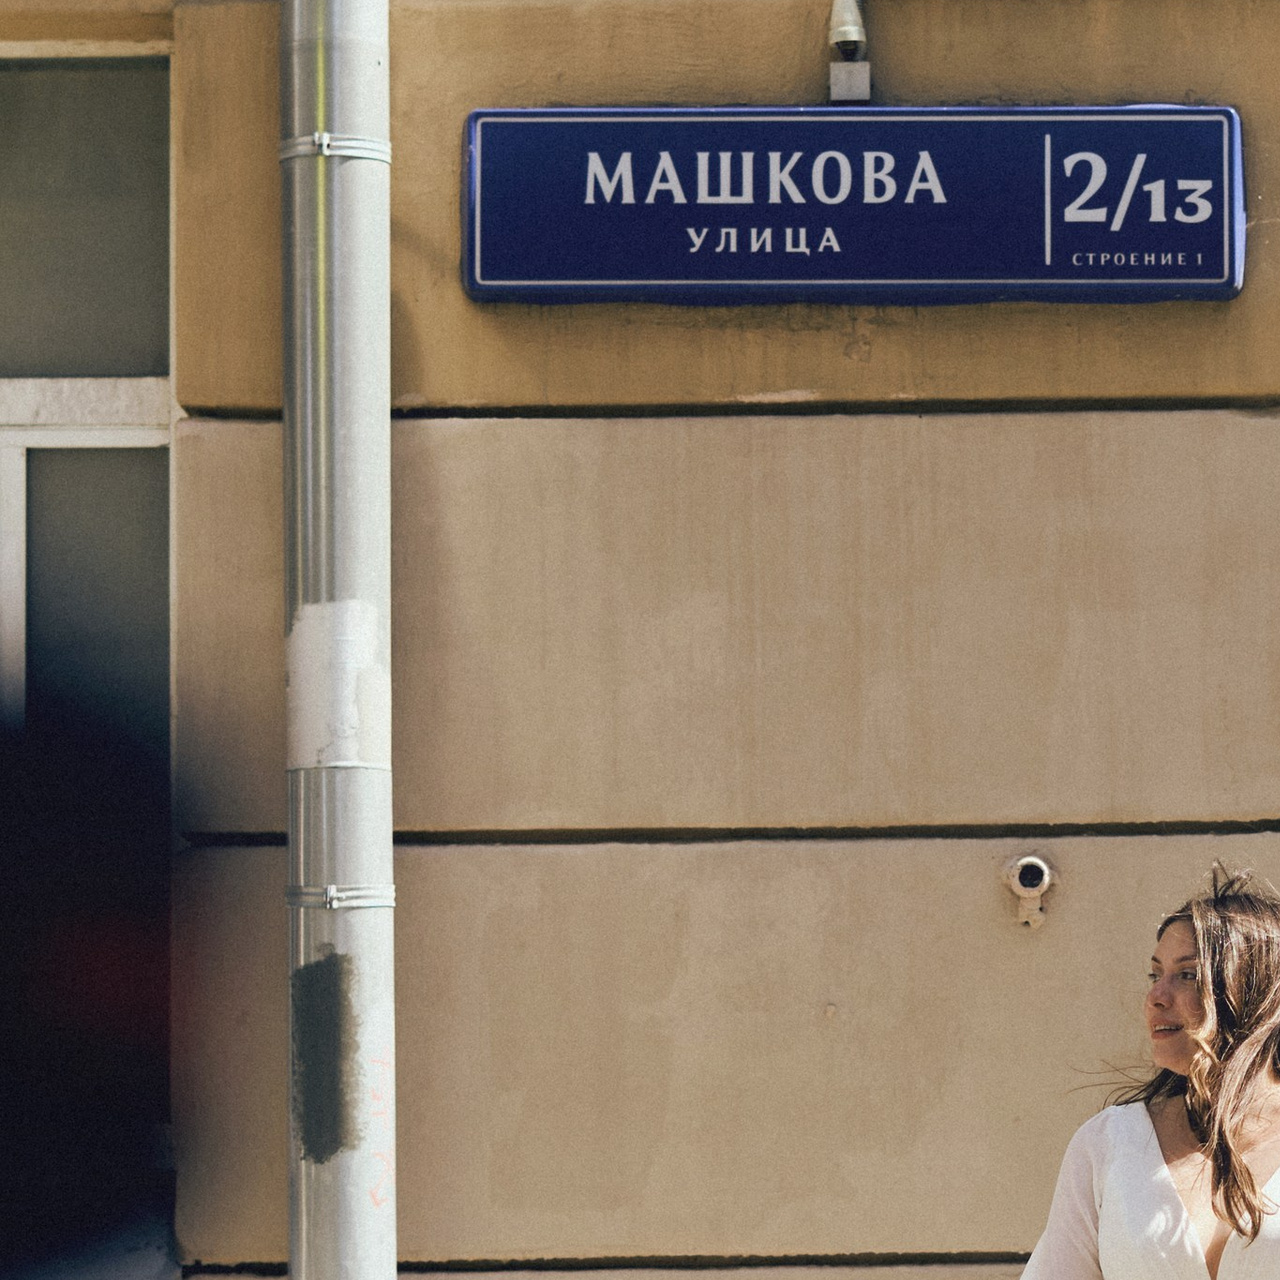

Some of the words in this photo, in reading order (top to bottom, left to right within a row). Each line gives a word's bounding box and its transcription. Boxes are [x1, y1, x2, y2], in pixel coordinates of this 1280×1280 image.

[584, 150, 947, 205] МАШКОВА
[1063, 151, 1213, 232] 2/13
[685, 227, 842, 256] УЛИЦА
[1072, 252, 1187, 266] СТРОЕНИЕ
[1196, 252, 1203, 266] 1
